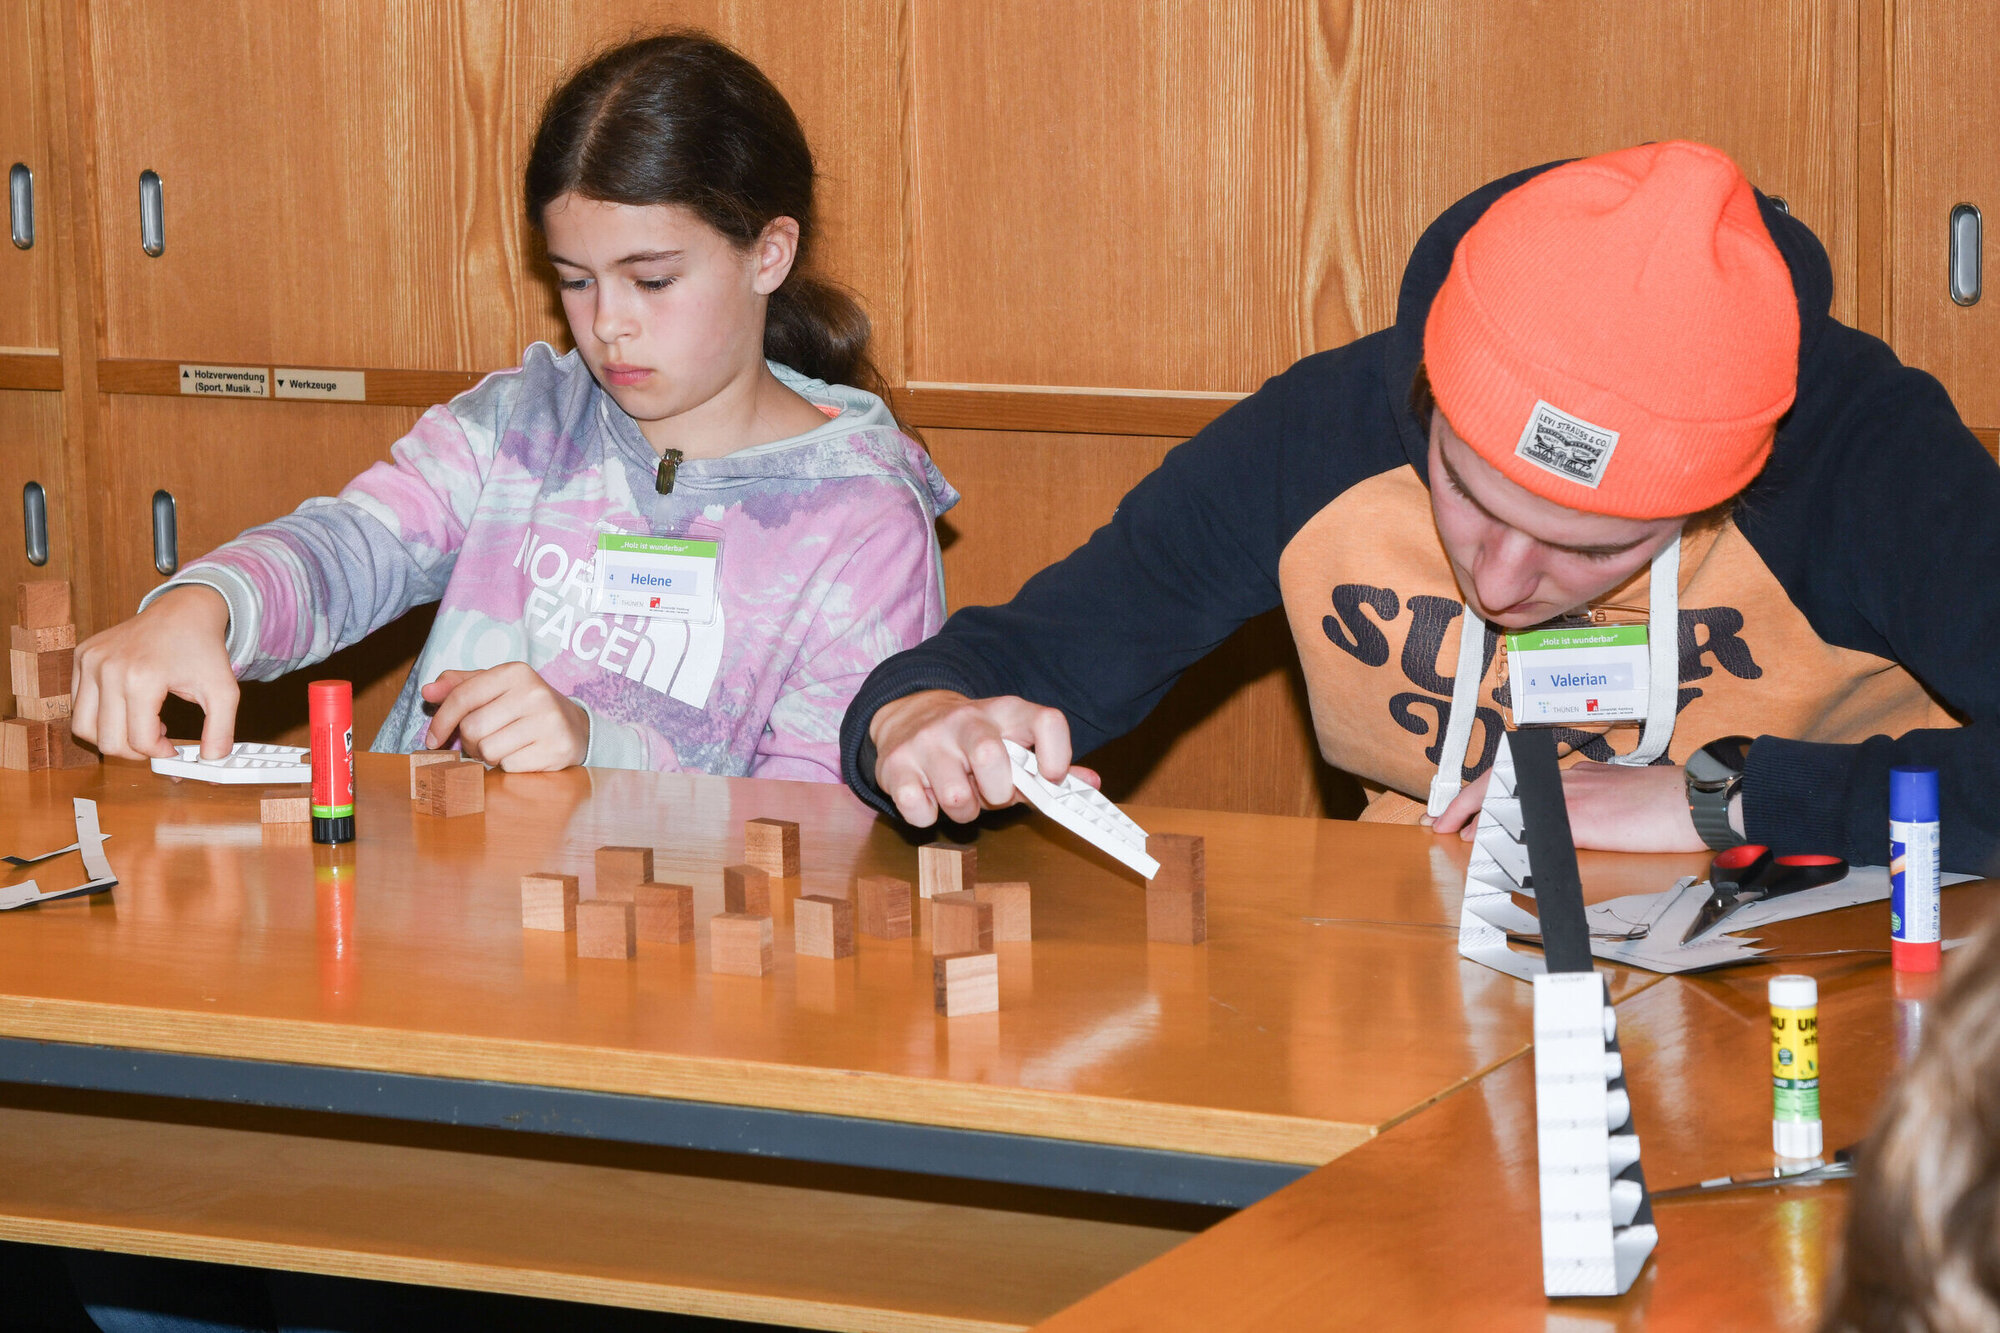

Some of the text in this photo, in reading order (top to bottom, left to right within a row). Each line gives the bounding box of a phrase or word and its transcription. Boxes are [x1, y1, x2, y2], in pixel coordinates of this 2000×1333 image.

[194, 369, 265, 382] Holzverwendung
[195, 382, 224, 393] (Sport,
[225, 383, 250, 393] Musik
[289, 379, 337, 391] Werkzeuge
[1539, 414, 1556, 427] LEVI
[1557, 422, 1588, 441] STRAUSS
[1595, 438, 1607, 447] CO.
[640, 542, 649, 551] ist
[609, 573, 673, 588] 4 Helene
[525, 587, 640, 675] FACE
[1322, 584, 1763, 708] SUR
[1561, 636, 1571, 646] ist
[1530, 672, 1608, 688] 4 Valerian
[1798, 1016, 1818, 1031] UH
